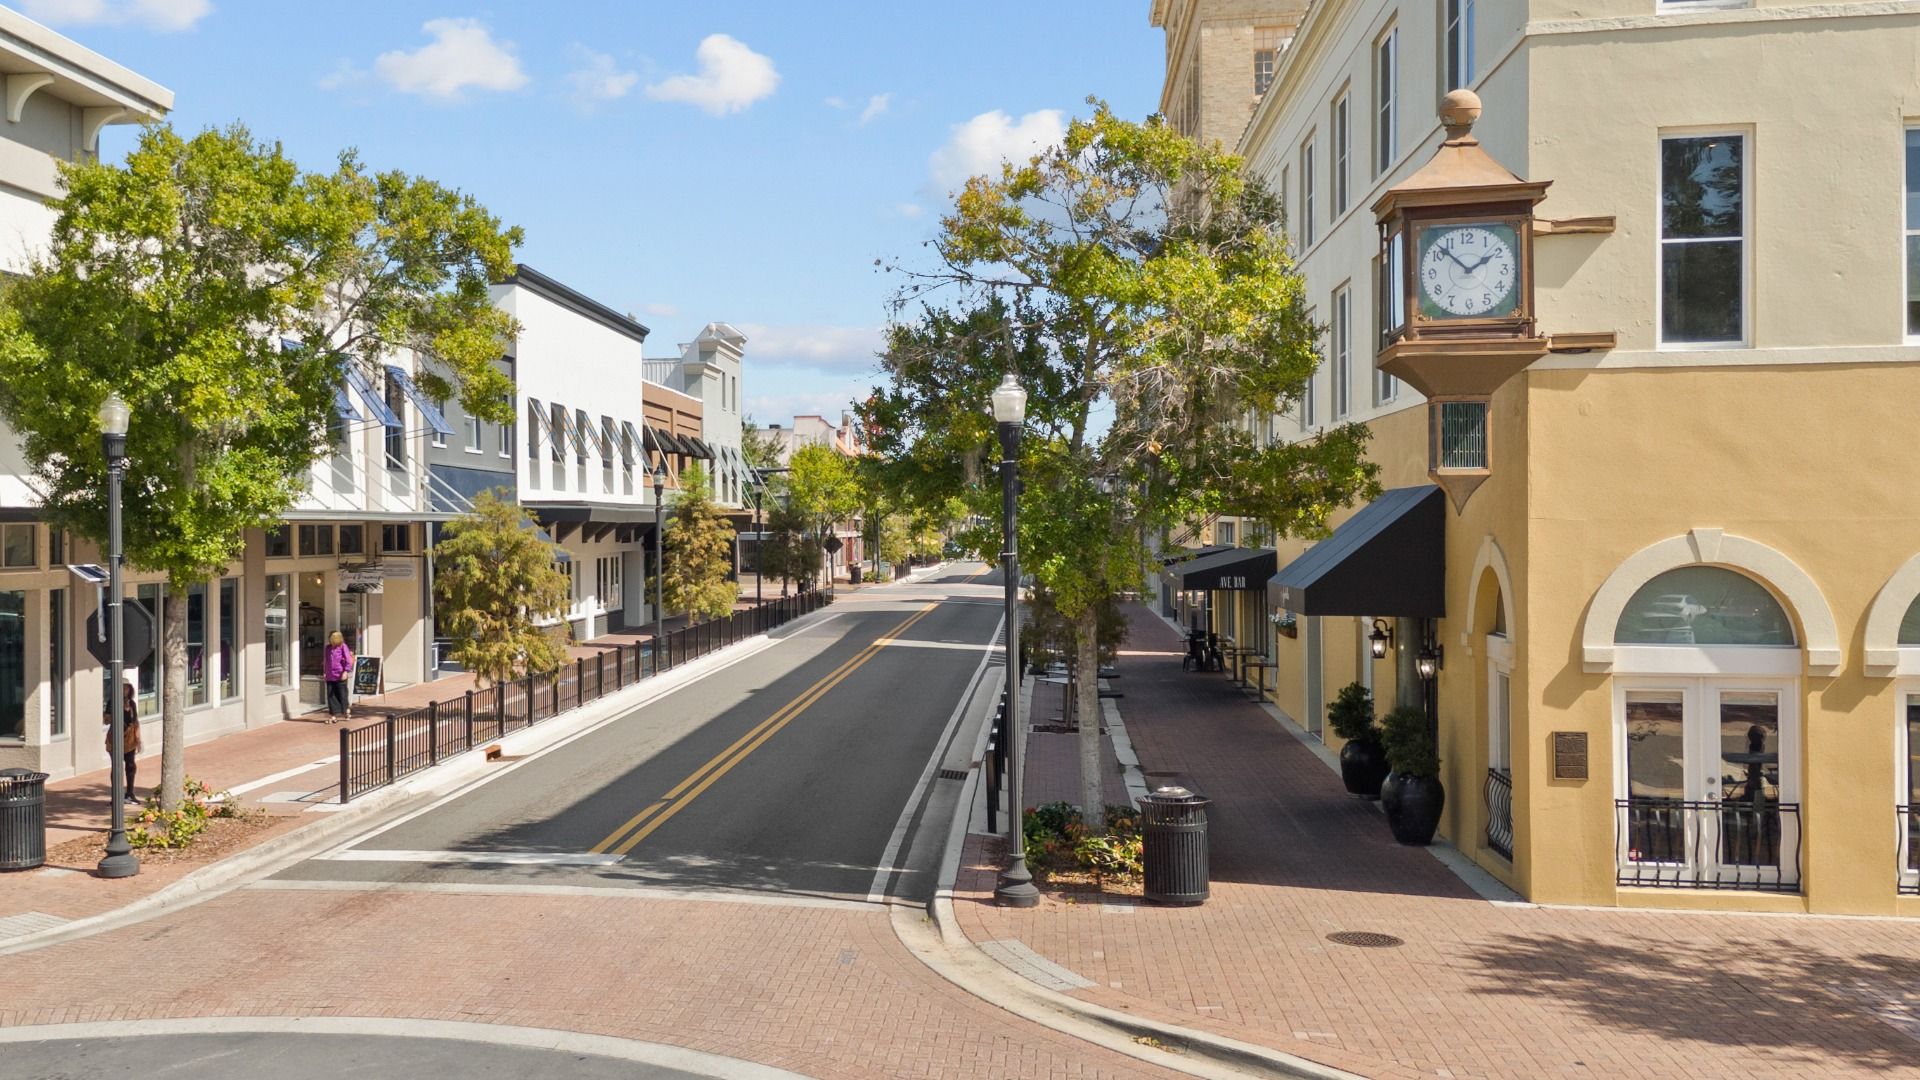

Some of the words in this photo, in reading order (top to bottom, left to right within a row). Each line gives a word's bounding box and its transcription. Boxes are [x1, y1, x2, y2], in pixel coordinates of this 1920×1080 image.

[1446, 237, 1454, 250] 11
[1460, 232, 1475, 245] 12
[1483, 236, 1488, 248] 1
[1432, 250, 1445, 262] 10
[1494, 247, 1503, 259] 2
[1428, 267, 1437, 280] 9
[1500, 263, 1509, 276] 3
[1433, 283, 1442, 296] 8
[1494, 280, 1505, 292] 4
[1448, 295, 1456, 307] 7
[1465, 298, 1474, 310] 6
[1482, 293, 1492, 306] 5
[1233, 576, 1246, 588] BAR
